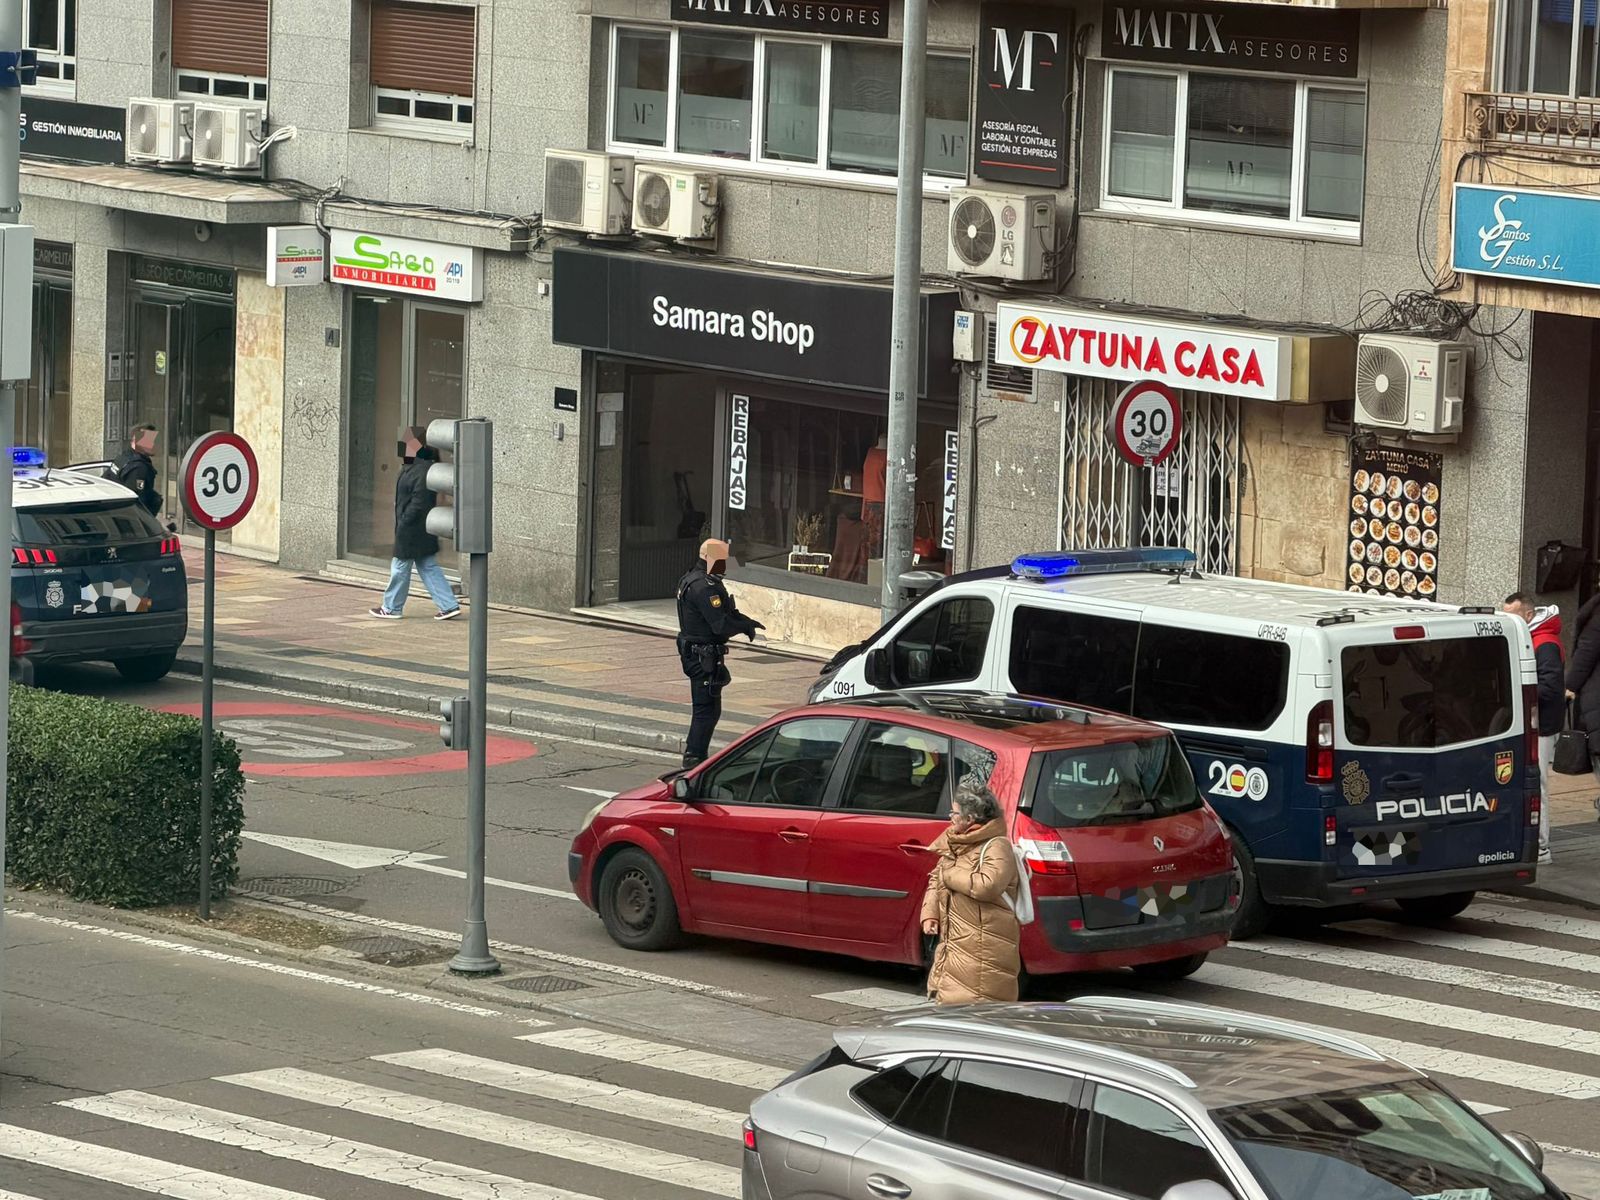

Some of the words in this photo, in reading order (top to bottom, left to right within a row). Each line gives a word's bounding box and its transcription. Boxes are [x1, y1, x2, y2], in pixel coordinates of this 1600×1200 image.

[778, 3, 880, 25] ASESORES
[1228, 39, 1348, 63] ASESORES
[32, 121, 67, 135] GESTIÓN
[67, 126, 122, 142] INMOBILIARIA
[982, 121, 1015, 132] ASESORÍA
[981, 142, 1011, 154] GESTIÓN
[1011, 146, 1022, 155] DE
[1022, 147, 1058, 159] EMPRESAS
[982, 132, 1013, 143] LABORAL
[1014, 135, 1020, 144] Y
[1020, 136, 1057, 148] CONTABLE
[1478, 194, 1531, 242] Santos
[1001, 229, 1014, 240] LG
[1480, 240, 1536, 269] Gestión
[1538, 255, 1564, 271] S.L.
[175, 268, 223, 288] CARMELITAS
[335, 266, 434, 290] INMOBILIARIA
[445, 262, 463, 278] API
[652, 295, 745, 338] Samara
[750, 309, 815, 355] Shop
[1020, 319, 1167, 374] ZAYTUNA
[1174, 340, 1265, 388] CASA
[1130, 408, 1167, 438] 30
[730, 397, 748, 506] REBAJAS
[1365, 450, 1405, 463] ZAYTUNA
[1406, 454, 1430, 470] CASA
[201, 463, 242, 498] 30
[1208, 760, 1269, 802] 200
[1375, 788, 1490, 822] POLICÍA
[1478, 850, 1515, 864] @policia
